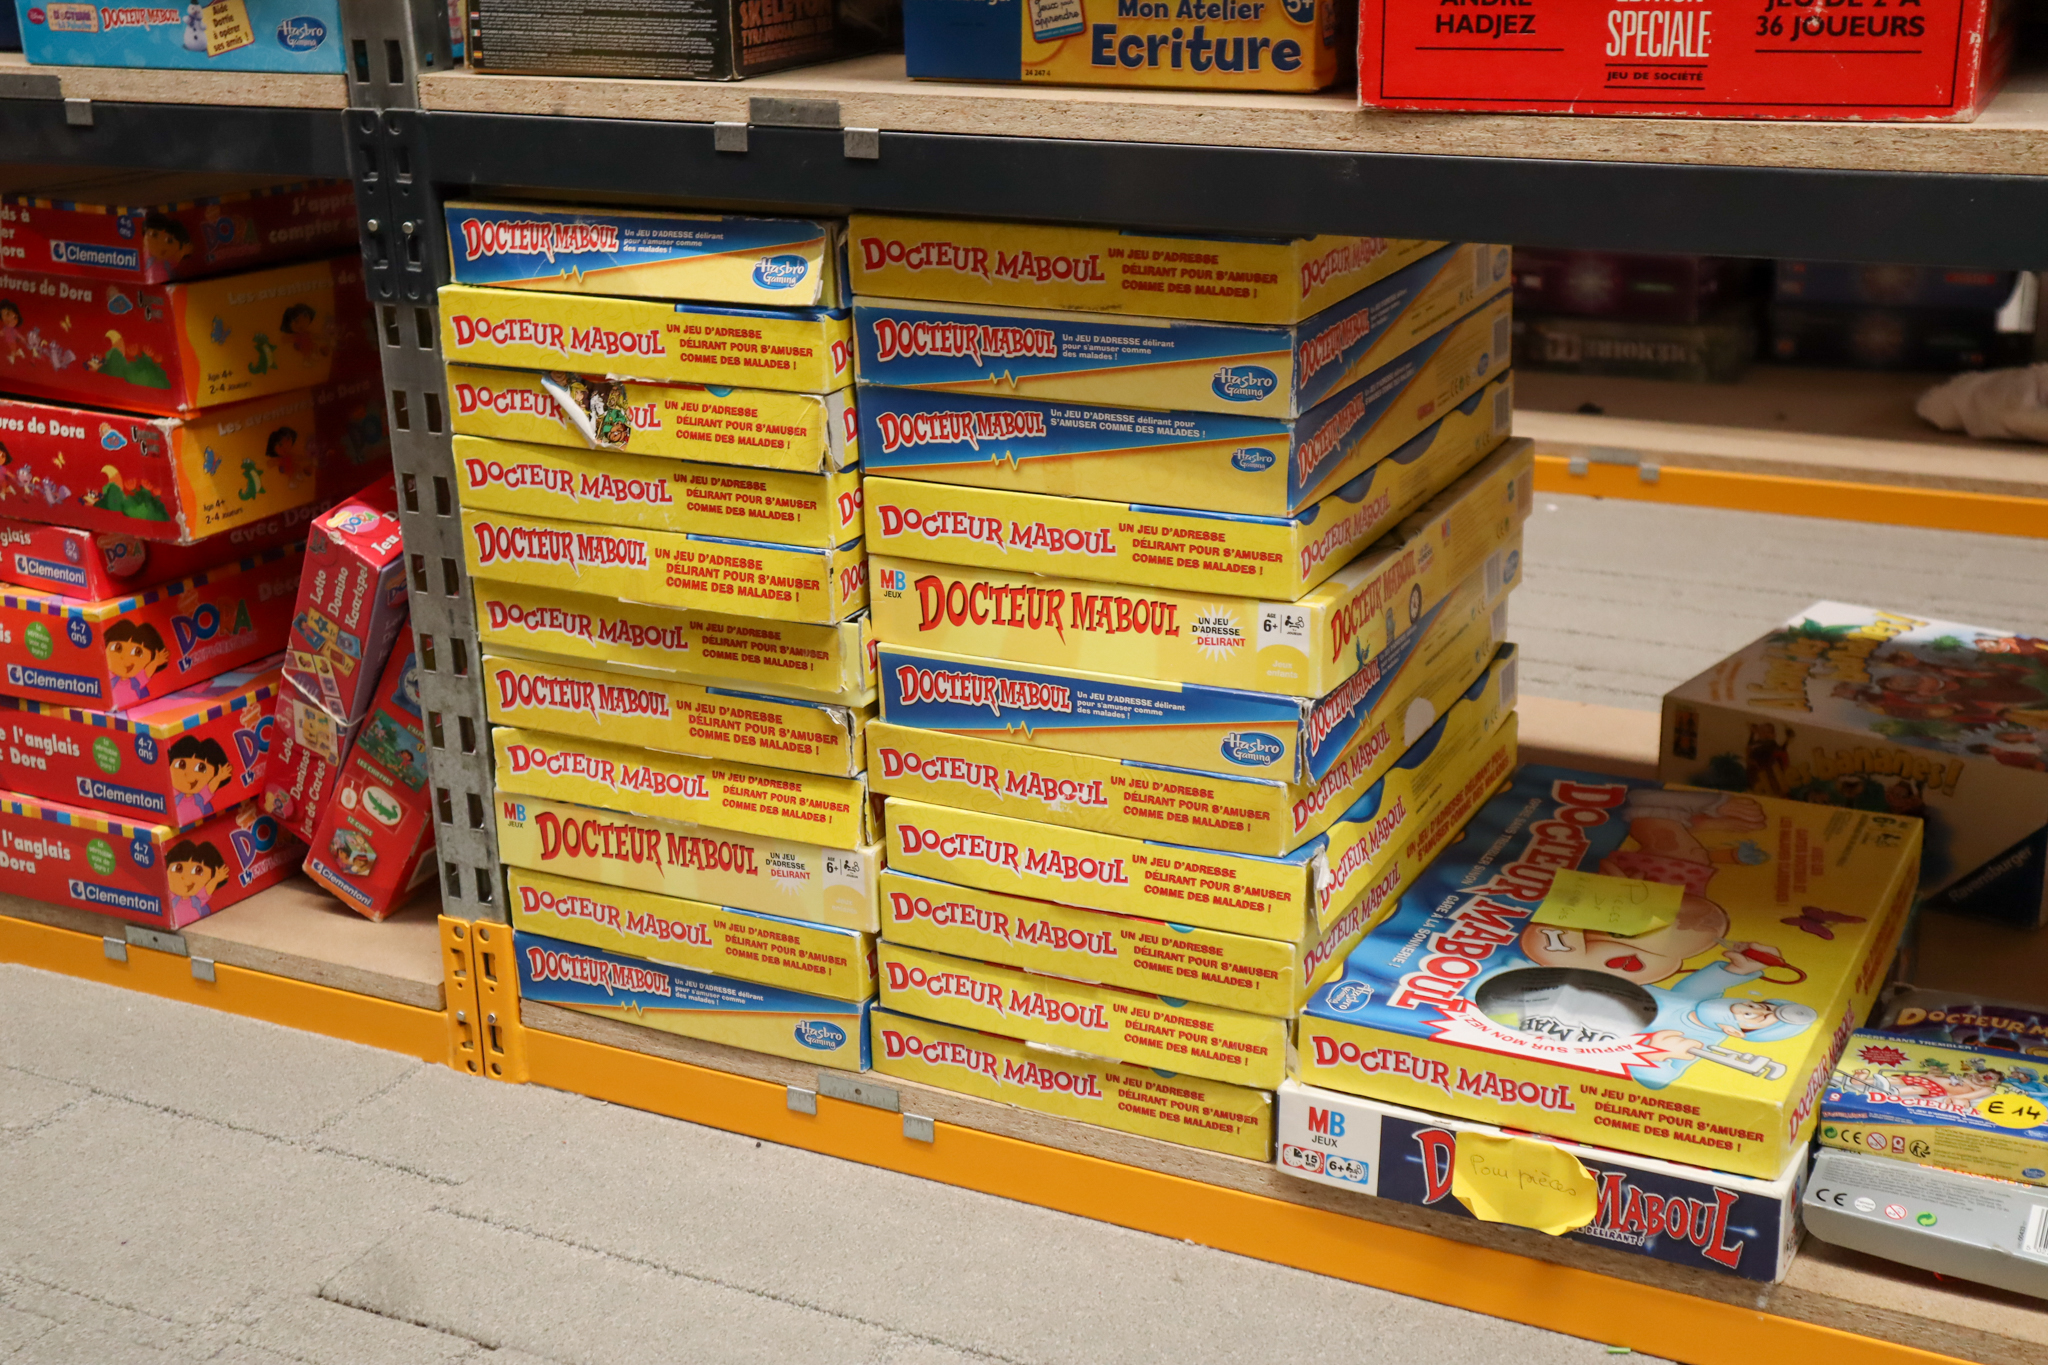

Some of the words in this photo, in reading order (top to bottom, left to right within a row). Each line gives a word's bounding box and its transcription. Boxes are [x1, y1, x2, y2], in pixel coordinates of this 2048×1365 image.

[101, 7, 150, 30] DOCTEUR
[148, 9, 181, 24] MABOUL
[1034, 10, 1079, 27] apprendre
[1118, 0, 1169, 19] Mon
[1176, 0, 1265, 21] Atelier
[220, 25, 240, 37] opérer
[278, 17, 323, 37] Hasbro
[1436, 14, 1536, 39] HADJEZ
[1606, 10, 1712, 58] SPECIALE
[1756, 16, 1783, 36] 36
[1790, 15, 1925, 41] JOUEURS
[214, 43, 225, 52] ses
[226, 36, 243, 48] amis
[1092, 23, 1302, 72] Ecriture
[1607, 72, 1628, 80] JEU
[1633, 72, 1649, 80] DE
[1654, 71, 1704, 81] SOCIÉTÉ
[462, 218, 554, 263] DOCTEUR
[554, 223, 619, 254] MABOUL
[67, 245, 137, 267] Clementoni
[755, 258, 804, 276] Hasbro
[861, 237, 990, 285] DOCTEUR
[995, 250, 1105, 285] MABOUL
[39, 276, 55, 296] de
[60, 282, 92, 302] Dora
[763, 274, 799, 287] Gaming
[451, 314, 568, 357] DOCTEUR
[571, 327, 667, 356] MABOUL
[667, 324, 680, 333] UN
[684, 326, 702, 336] JEU
[704, 326, 762, 339] D'ADRESSE
[874, 318, 982, 367] DOCTEUR
[979, 327, 1057, 358] MABOUL
[1062, 333, 1073, 342] Un
[1075, 334, 1092, 343] JEU
[1093, 336, 1140, 345] D'ADRESSE
[1142, 338, 1174, 348] délirant
[680, 338, 726, 351] DÉLIRANT
[730, 341, 758, 353] POUR
[761, 345, 813, 357] S'AMUSER
[1062, 350, 1075, 358] des
[1078, 352, 1112, 361] malades
[1063, 343, 1081, 352] pour
[1083, 344, 1120, 353] s'amuser
[1121, 347, 1151, 355] comme
[680, 353, 717, 365] COMME
[720, 356, 740, 366] DES
[744, 357, 790, 370] MALADES
[1214, 367, 1273, 389] Hasbro
[1225, 384, 1263, 399] Gaming
[454, 383, 570, 429] DOCTEUR
[27, 417, 45, 434] de
[49, 420, 85, 439] Dora
[877, 411, 979, 453] DOCTEUR
[977, 410, 1046, 439] MABOUL
[879, 505, 1007, 554] DOCTEUR
[1009, 520, 1117, 557] MABOUL
[473, 522, 579, 575] DOCTEUR
[577, 528, 649, 569] MABOUL
[28, 558, 85, 586] Clementoni
[880, 569, 906, 591] MB
[310, 570, 326, 605] Lotto
[326, 566, 349, 618] Domino
[345, 561, 369, 630] Kaartspel
[884, 590, 902, 599] JEUX
[914, 574, 1066, 646] DOCTEUR
[1071, 591, 1180, 638] MABOUL
[1198, 616, 1210, 626] UN
[1212, 618, 1229, 627] JEU
[70, 621, 86, 634] 4-7
[1192, 625, 1241, 637] D'ADRESSE
[1262, 619, 1278, 632] 6+
[71, 633, 87, 645] ans
[1197, 635, 1246, 648] DÉLIRANT
[24, 670, 99, 695] Clementoni
[896, 665, 1001, 717] DOCTEUR
[1000, 678, 1072, 713] MABOUL
[495, 670, 601, 724] DOCTEUR
[597, 683, 670, 719] MABOUL
[13, 725, 80, 757] l'anglais
[138, 738, 153, 751] 4-7
[280, 737, 294, 765] Loto
[11, 748, 46, 771] Dora
[138, 749, 154, 760] ans
[290, 749, 310, 801] Dominos
[308, 759, 326, 801] Cartes
[357, 758, 369, 772] LES
[368, 764, 394, 787] CHIFFRES
[1291, 767, 1355, 835] DOCTEUR
[1350, 722, 1391, 782] MABOUL
[93, 783, 164, 811] Clementoni
[305, 801, 317, 819] de
[300, 818, 312, 838] Jeu
[354, 821, 373, 837] CUBES
[2, 829, 70, 860] l'anglais
[535, 811, 665, 878] DOCTEUR
[666, 833, 759, 876] MABOUL
[1457, 780, 1627, 903] DOCTEUR
[0, 850, 36, 874] Dora
[899, 824, 1022, 879] DOCTEUR
[1025, 846, 1129, 885] MABOUL
[1132, 854, 1148, 864] UN
[1150, 856, 1170, 868] JEU
[1174, 860, 1236, 878] D'ADRESSE
[320, 867, 372, 906] Clementoni
[1144, 885, 1183, 899] COMME
[1188, 890, 1209, 902] DES
[1213, 893, 1263, 912] MALADES
[1145, 870, 1196, 886] DÉLIRANT
[1200, 877, 1229, 891] POUR
[1233, 883, 1291, 902] S'AMUSER
[85, 886, 160, 913] Clementoni
[519, 886, 623, 936] DOCTEUR
[626, 911, 712, 947] MABOUL
[1423, 918, 1439, 929] LA
[1387, 895, 1533, 1011] MABOUL
[1393, 928, 1430, 964] SONNERIE
[527, 947, 613, 995] DOCTEUR
[612, 964, 671, 998] MABOUL
[886, 961, 1007, 1019] DOCTEUR
[1008, 992, 1109, 1031] MABOUL
[1465, 1017, 1492, 1033] NEZ
[1896, 1007, 2031, 1035] DOCTEUR
[1495, 1031, 1528, 1046] MON
[1532, 1042, 1568, 1053] SUR
[1574, 1043, 1633, 1054] APPUIE
[1919, 1040, 1971, 1051] TREMBLER
[1312, 1036, 1454, 1097] DOCTEUR
[1456, 1068, 1575, 1112] MABOUL
[1867, 1092, 1966, 1116] DOCTEUR
[1988, 1101, 2005, 1114] E
[2011, 1105, 2040, 1119] 14
[1308, 1107, 1346, 1138] MB
[1311, 1135, 1337, 1148] JEUX
[1305, 1153, 1318, 1165] 15
[1470, 1154, 1509, 1179] Pour
[1585, 1166, 1743, 1269] MABOUL
